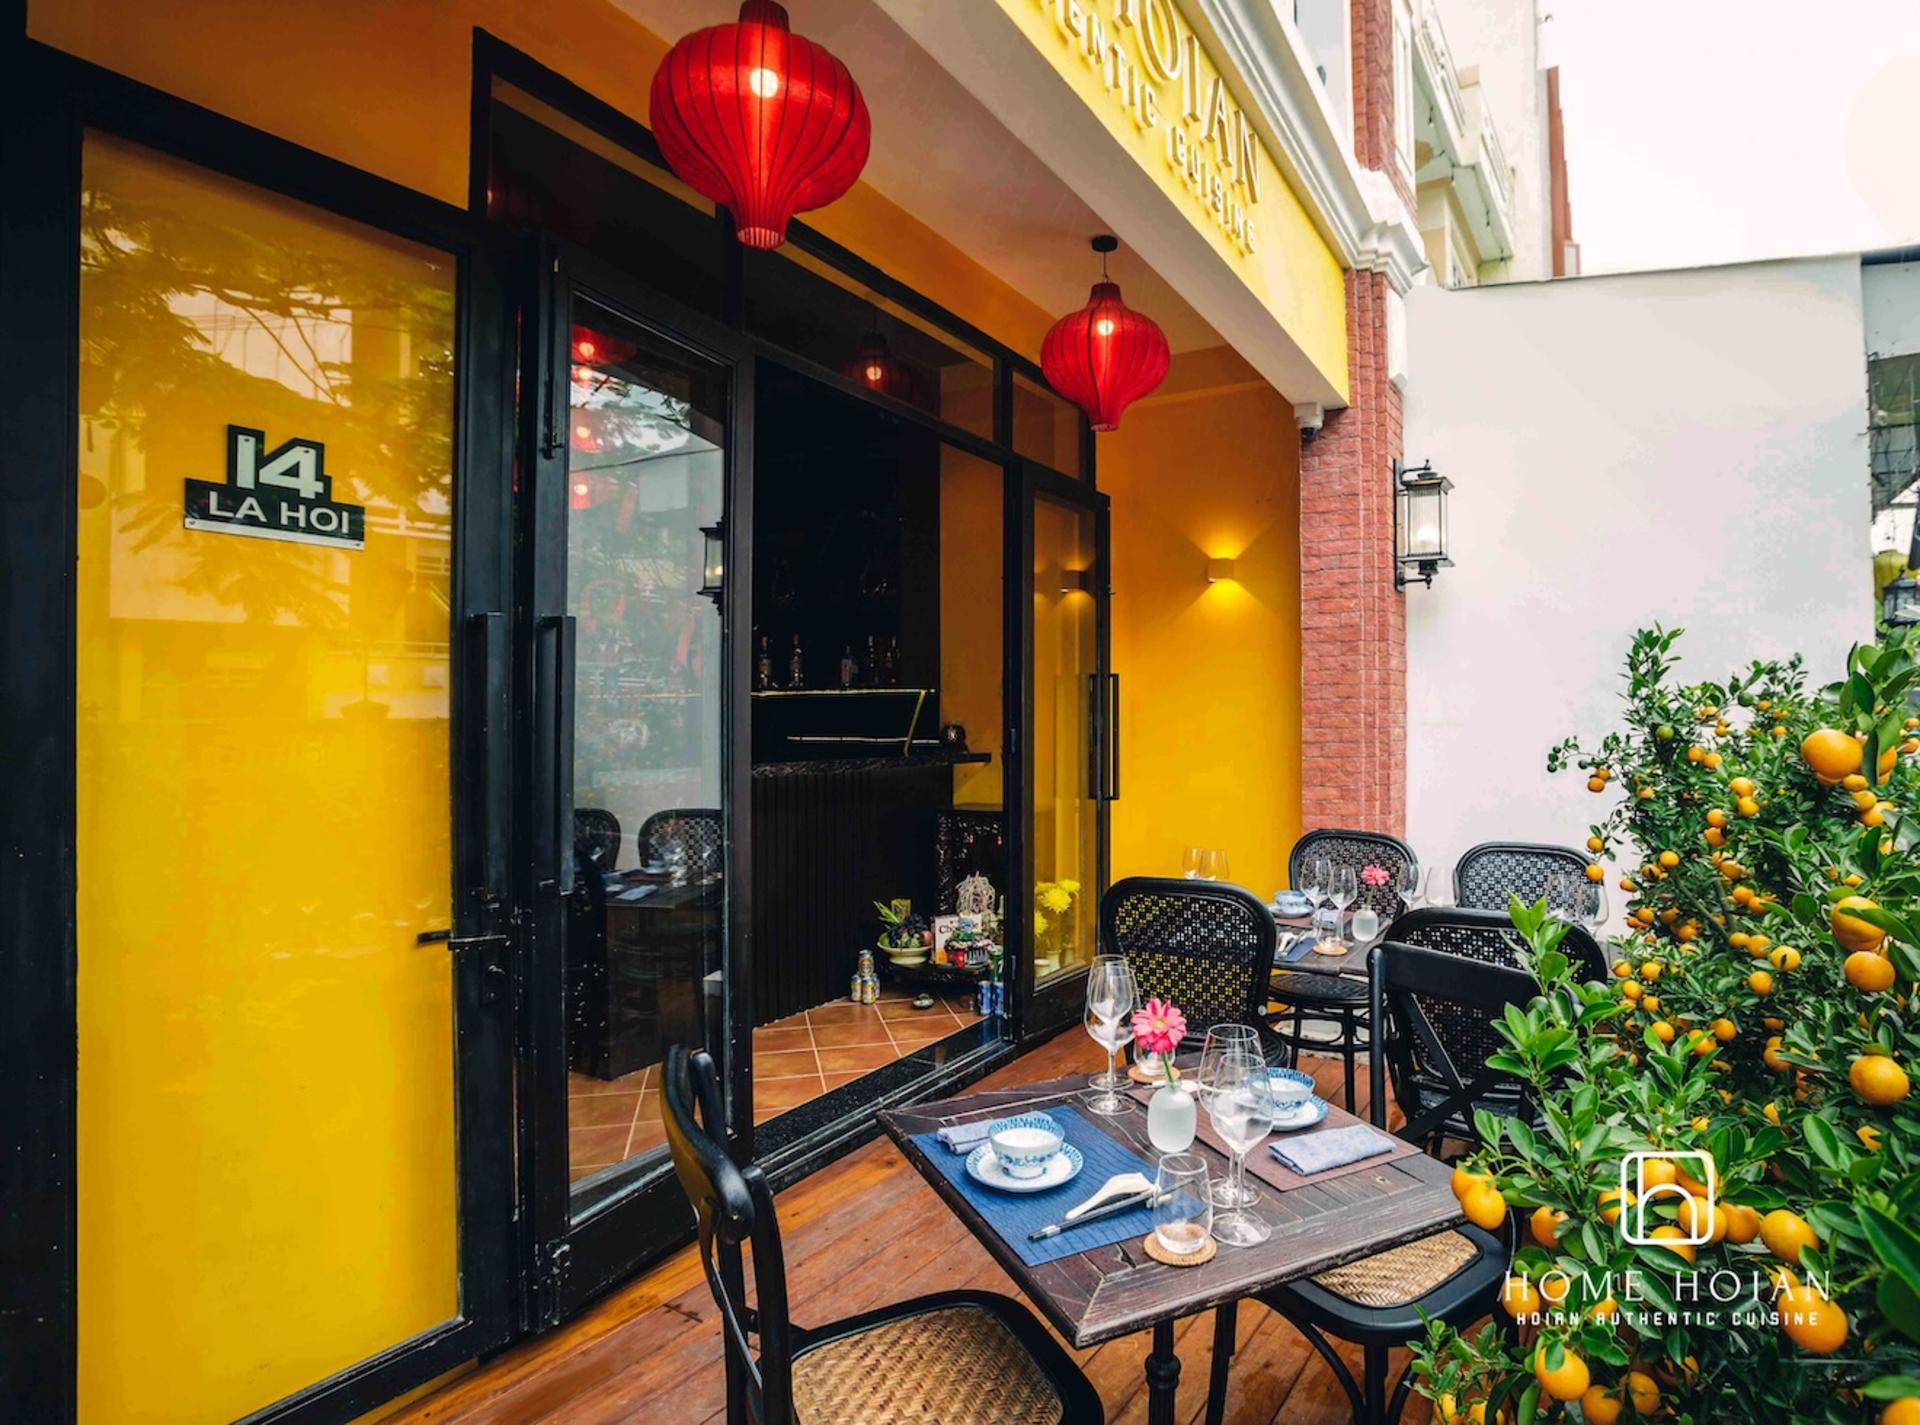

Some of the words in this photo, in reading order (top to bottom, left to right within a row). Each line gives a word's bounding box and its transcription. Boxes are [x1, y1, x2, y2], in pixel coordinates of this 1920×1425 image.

[1113, 0, 1260, 204] OIAN
[1165, 125, 1256, 254] CUISINE
[208, 490, 268, 523] LA
[279, 501, 349, 534] HOI
[236, 434, 325, 499] 14
